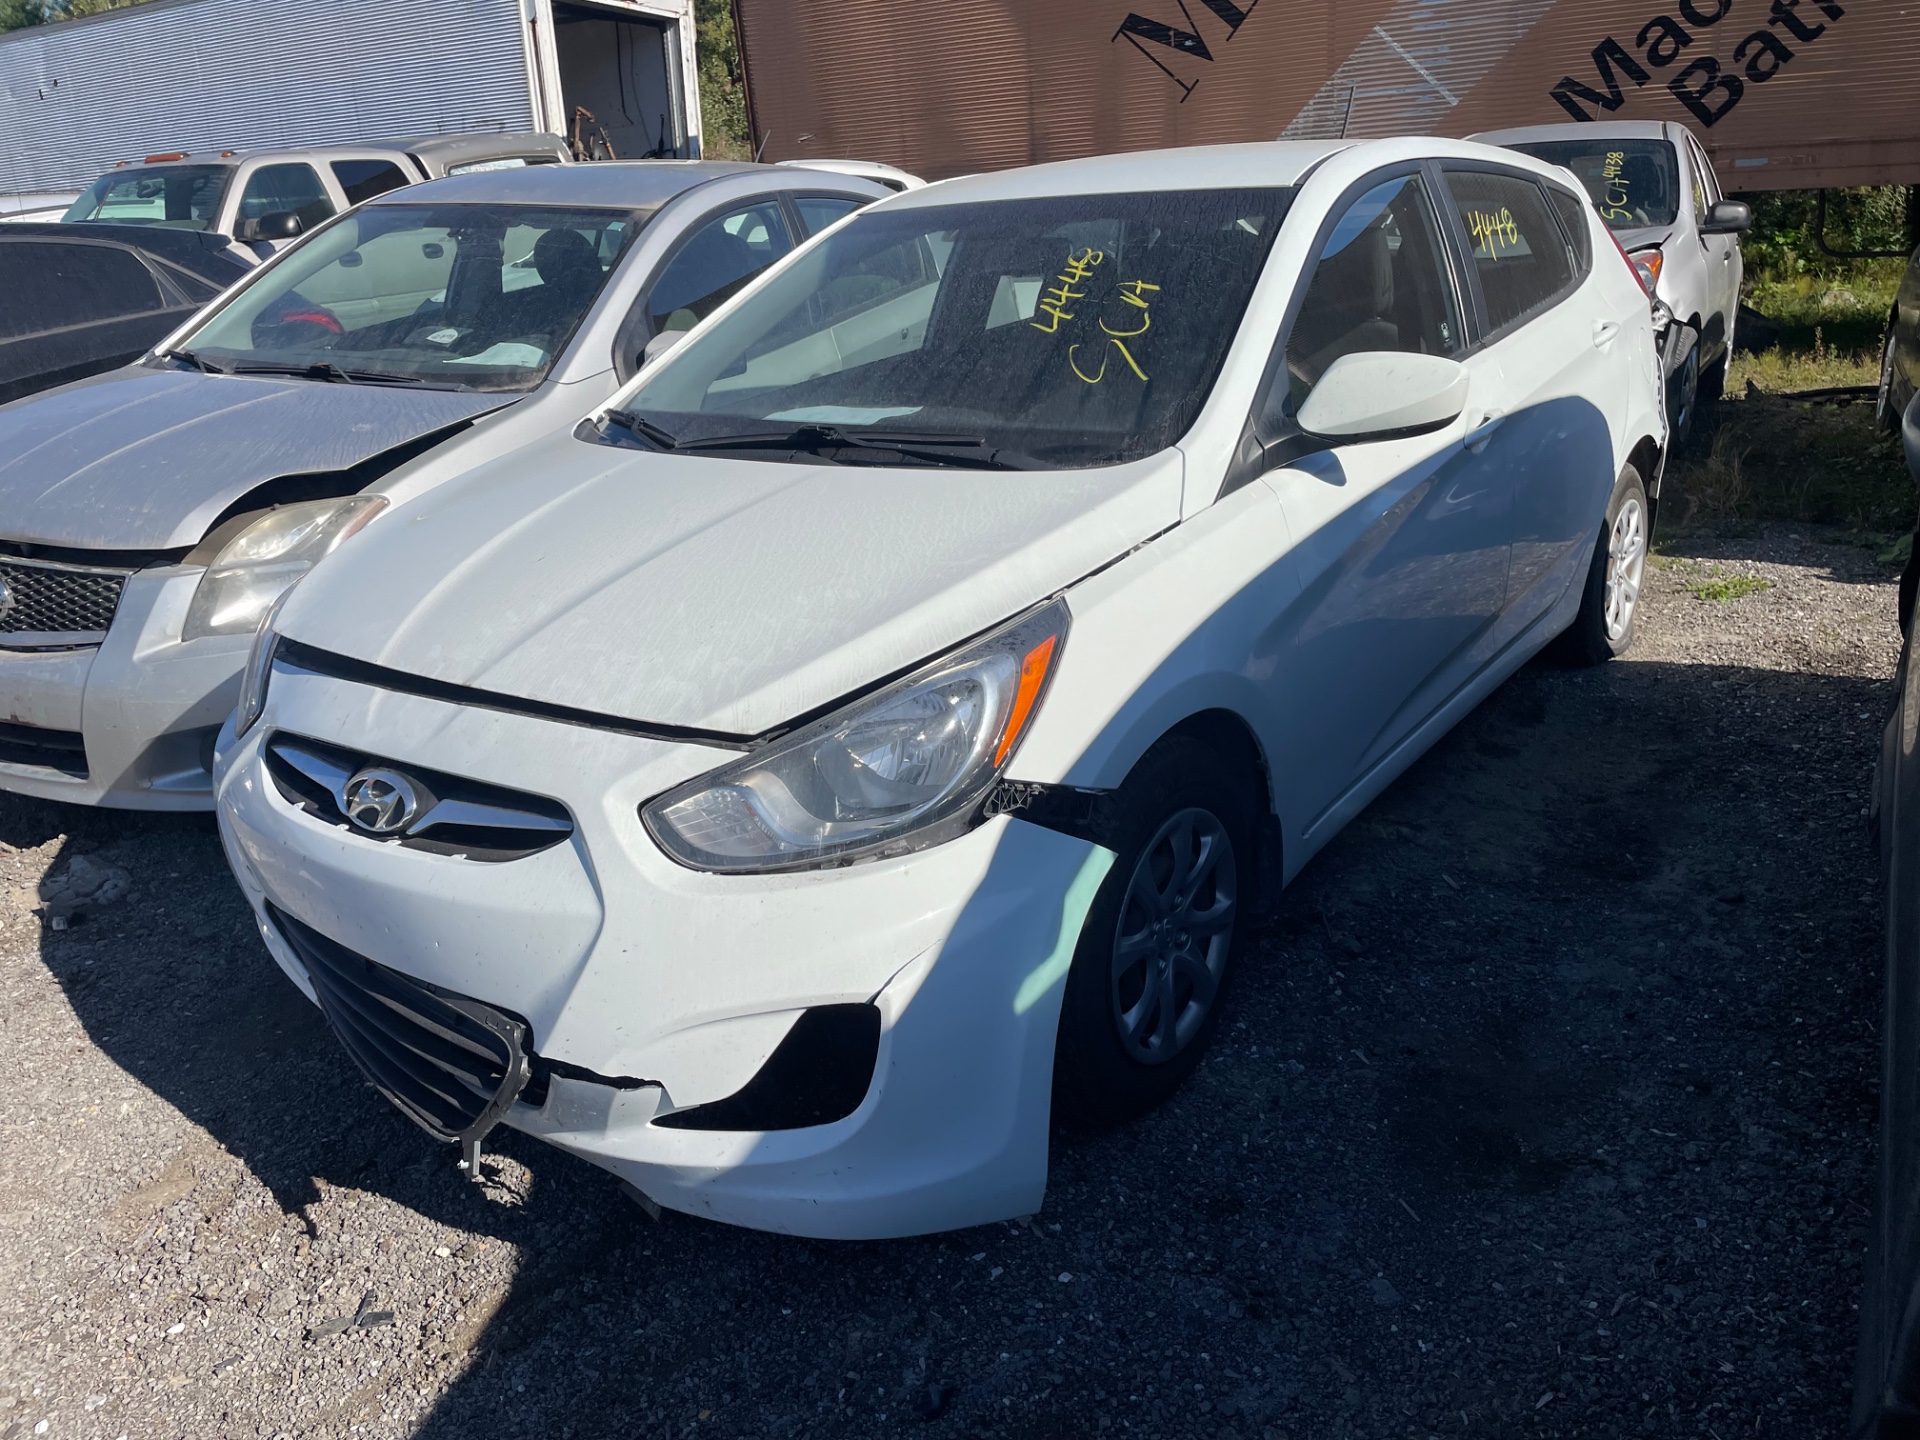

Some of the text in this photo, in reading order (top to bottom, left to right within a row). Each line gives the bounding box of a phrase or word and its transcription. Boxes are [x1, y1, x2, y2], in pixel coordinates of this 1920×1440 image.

[1666, 0, 1845, 128] Bat
[1600, 151, 1632, 220] SCA 4438
[1467, 206, 1518, 262] 4448
[1030, 247, 1104, 333] 4448
